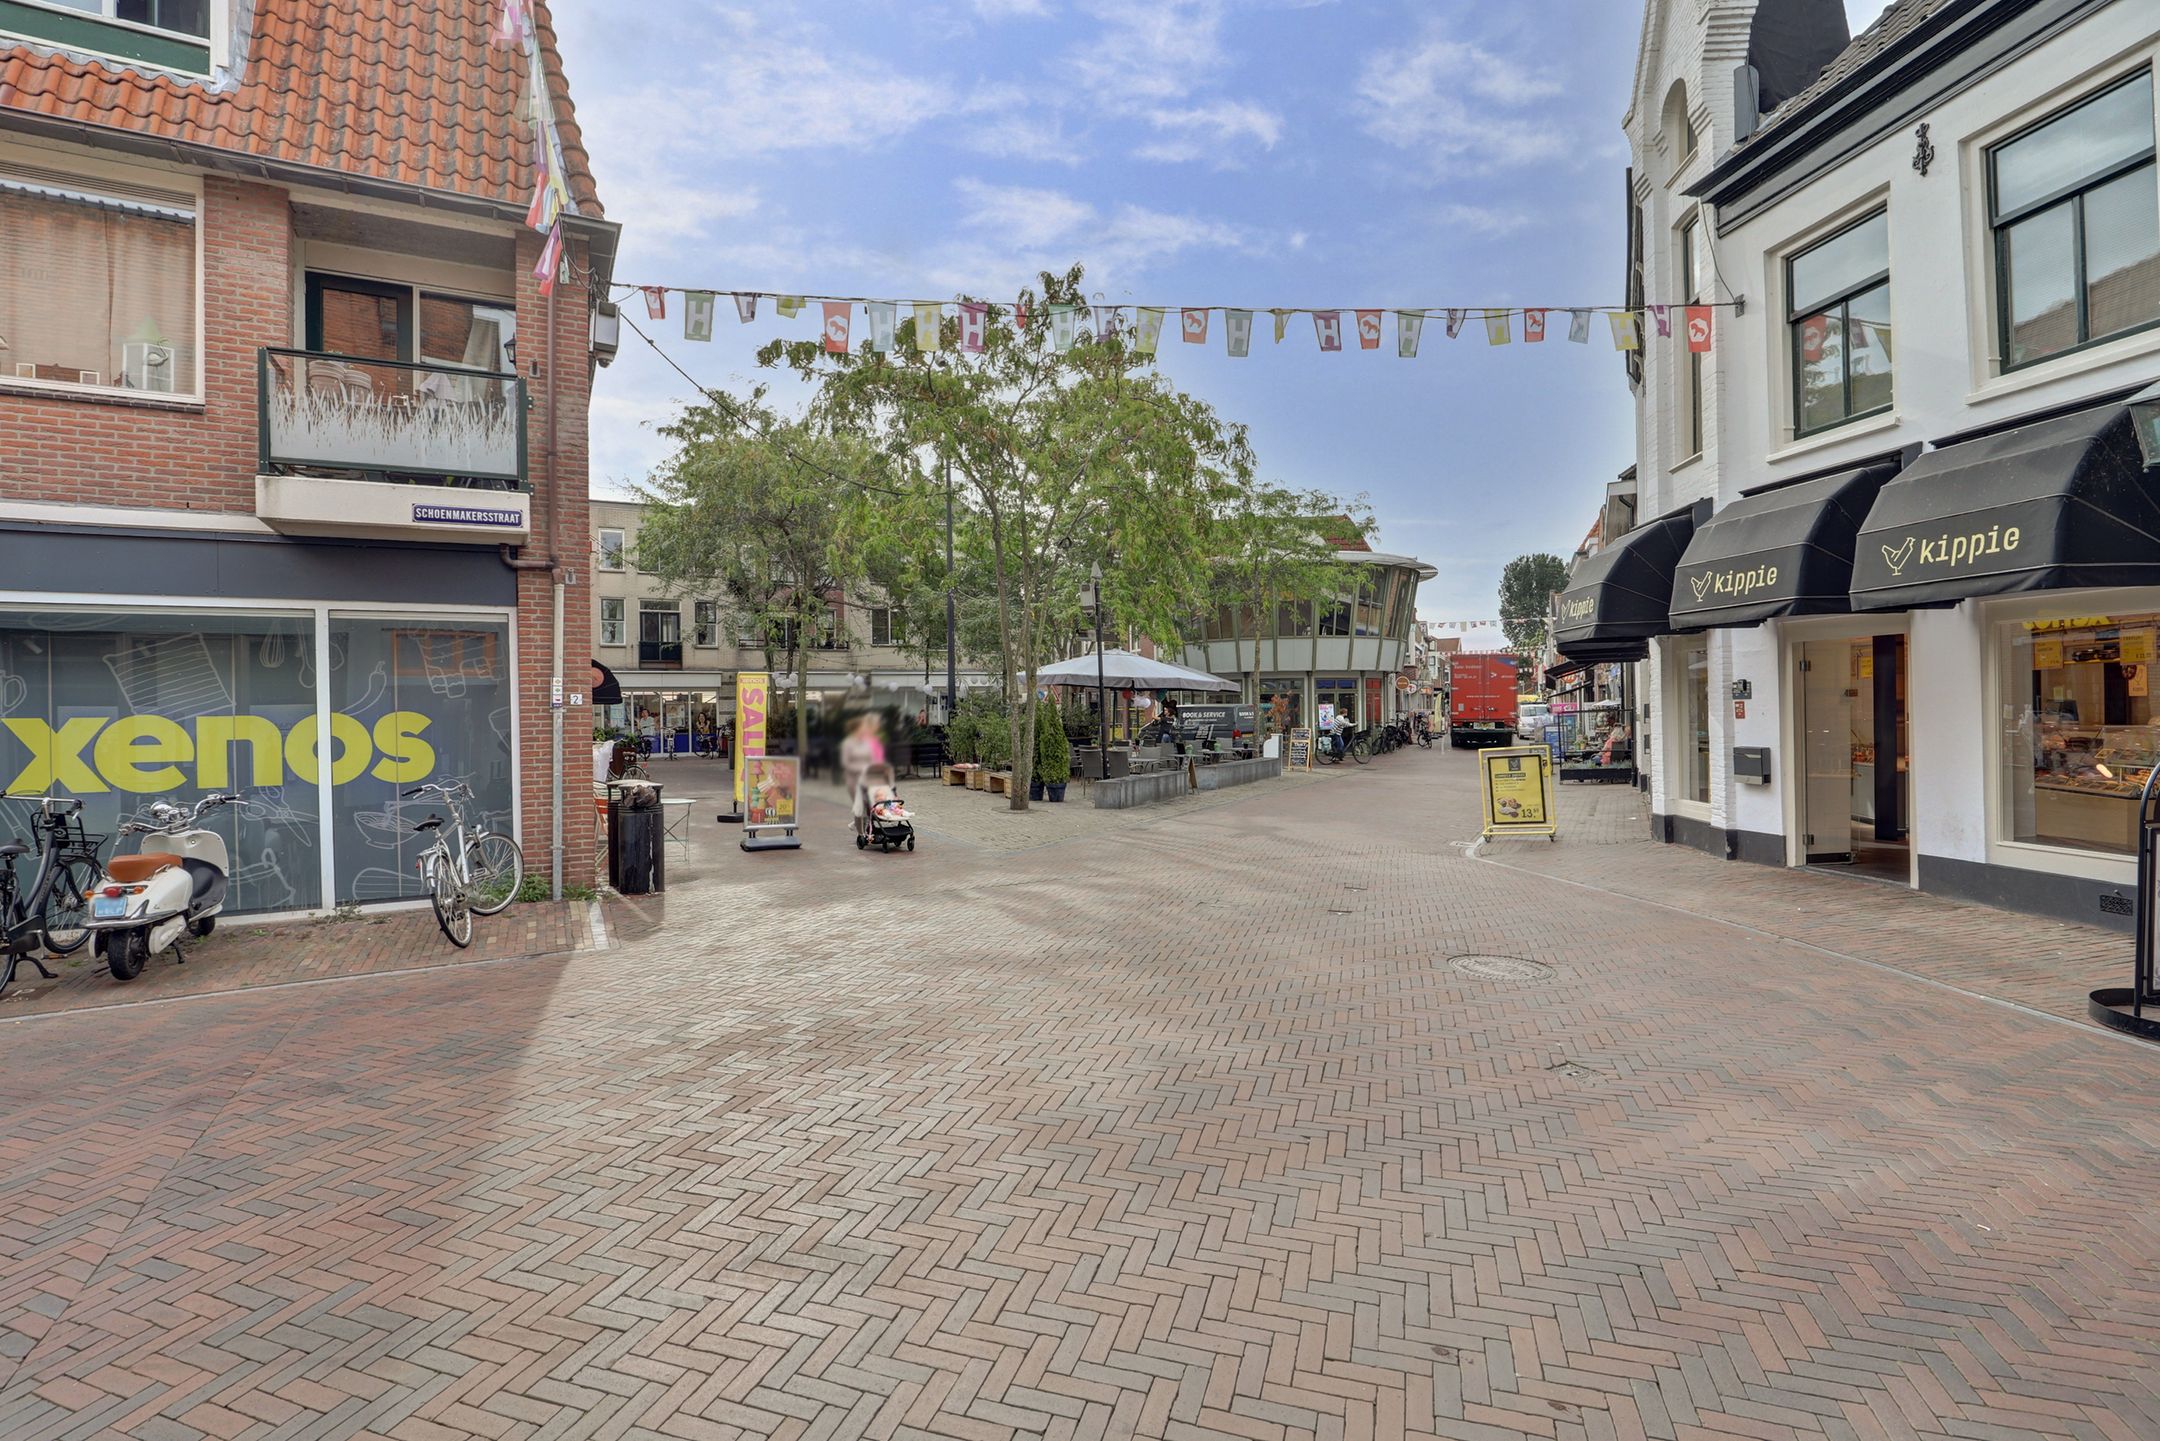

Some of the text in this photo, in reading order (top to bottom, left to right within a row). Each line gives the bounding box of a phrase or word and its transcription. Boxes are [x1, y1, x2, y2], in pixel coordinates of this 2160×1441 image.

[687, 300, 711, 335] H
[962, 312, 985, 347] H
[416, 507, 520, 524] SCHOENMAKERSSTRAAT
[1919, 524, 2020, 567] kippie
[1714, 564, 1778, 597] kippie
[1569, 595, 1595, 621] kippie
[572, 694, 579, 705] 2
[1182, 711, 1198, 719] BOOK
[1, 711, 437, 794] xenos
